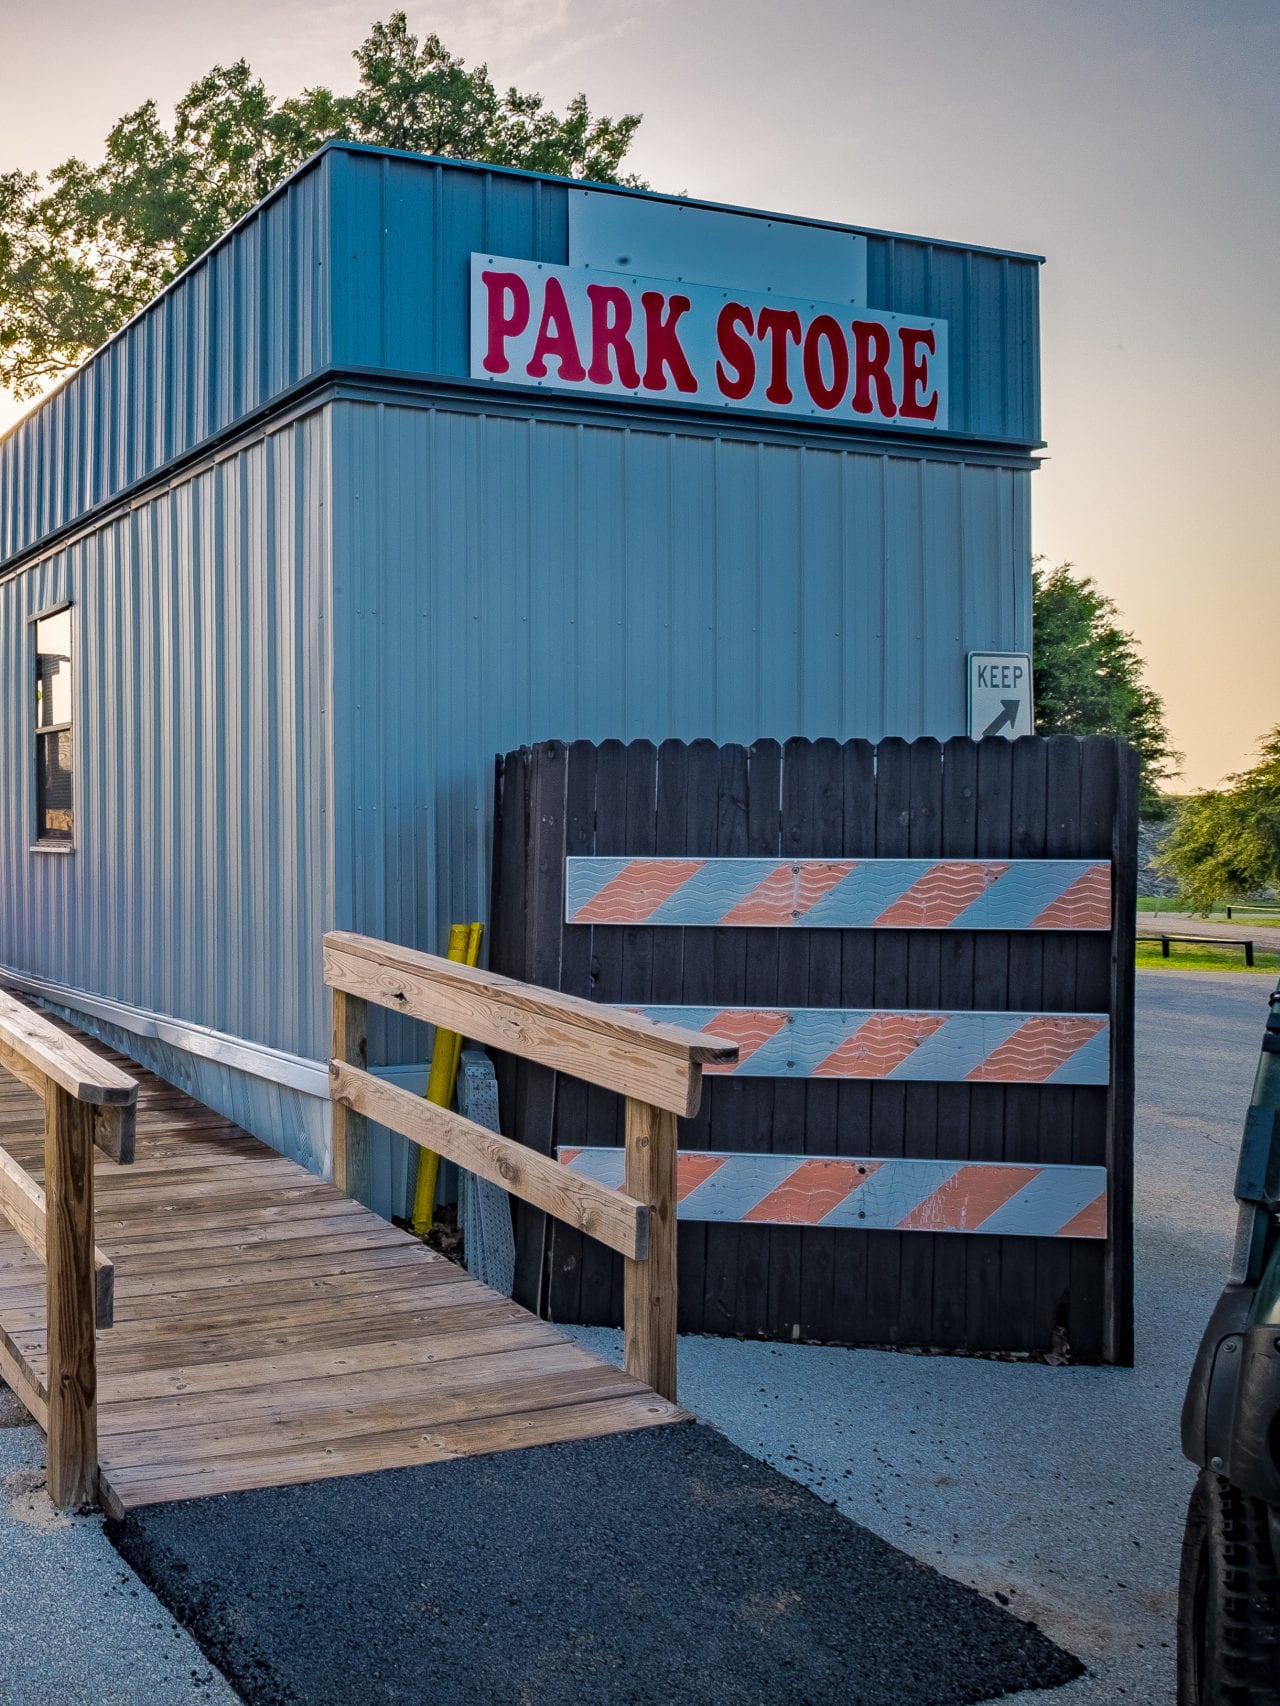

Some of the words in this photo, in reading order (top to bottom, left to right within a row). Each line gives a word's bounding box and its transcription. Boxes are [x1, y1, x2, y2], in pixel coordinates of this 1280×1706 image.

[481, 270, 699, 393] PARK
[716, 301, 939, 421] STORE
[977, 665, 1023, 688] KEEP
